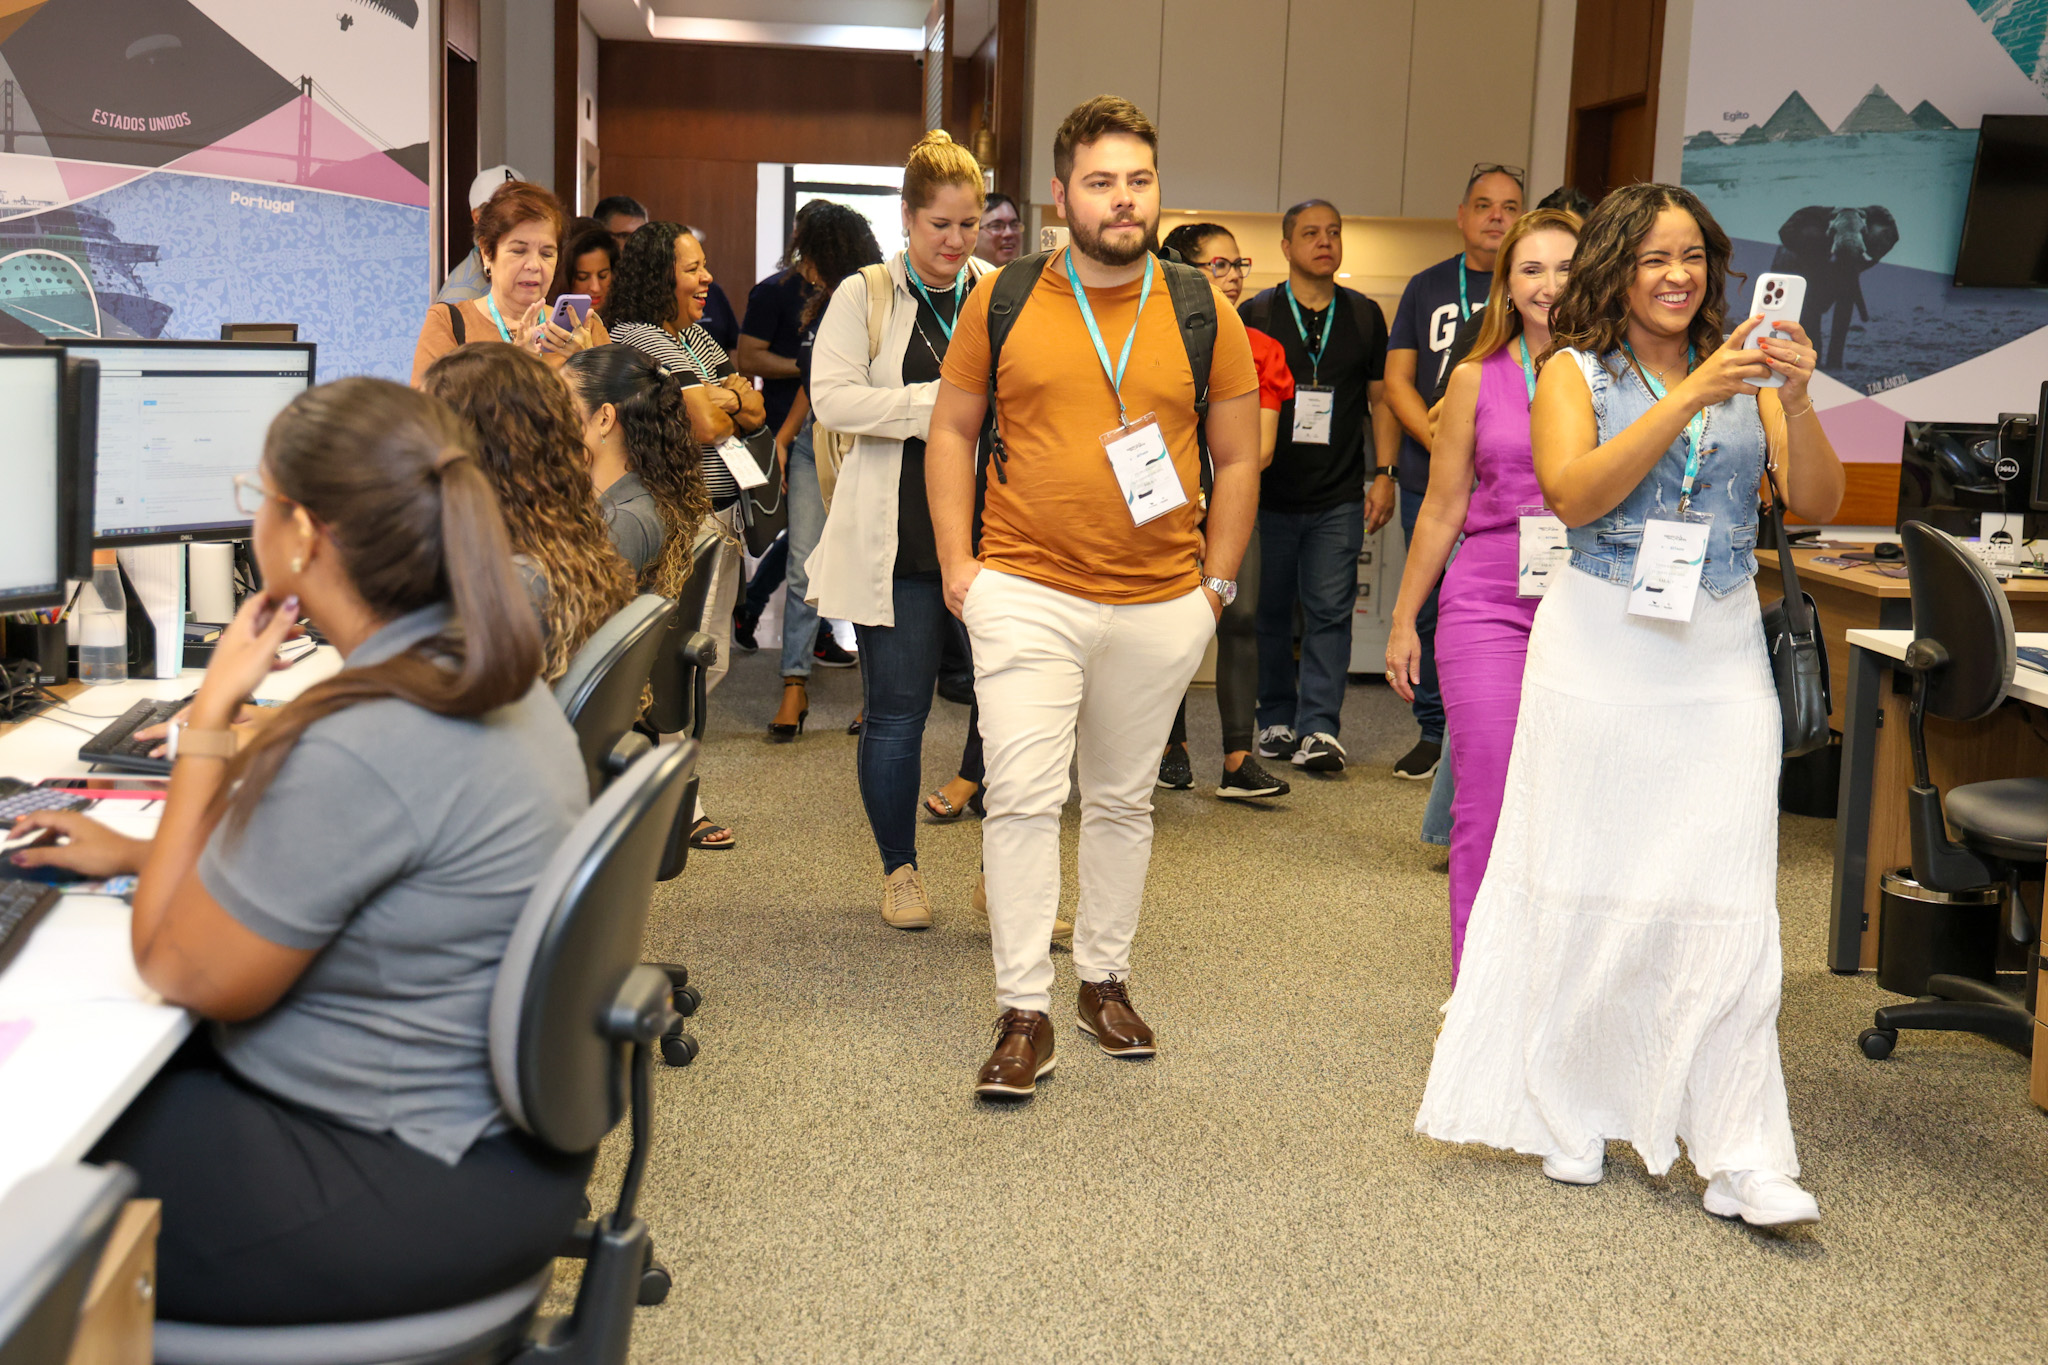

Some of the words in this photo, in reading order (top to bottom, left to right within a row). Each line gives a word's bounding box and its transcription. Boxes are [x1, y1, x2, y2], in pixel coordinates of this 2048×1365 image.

[91, 108, 146, 132] ESTADOS
[148, 112, 192, 132] UNIDOS
[1723, 110, 1750, 122] Egito
[230, 191, 296, 214] Portugal
